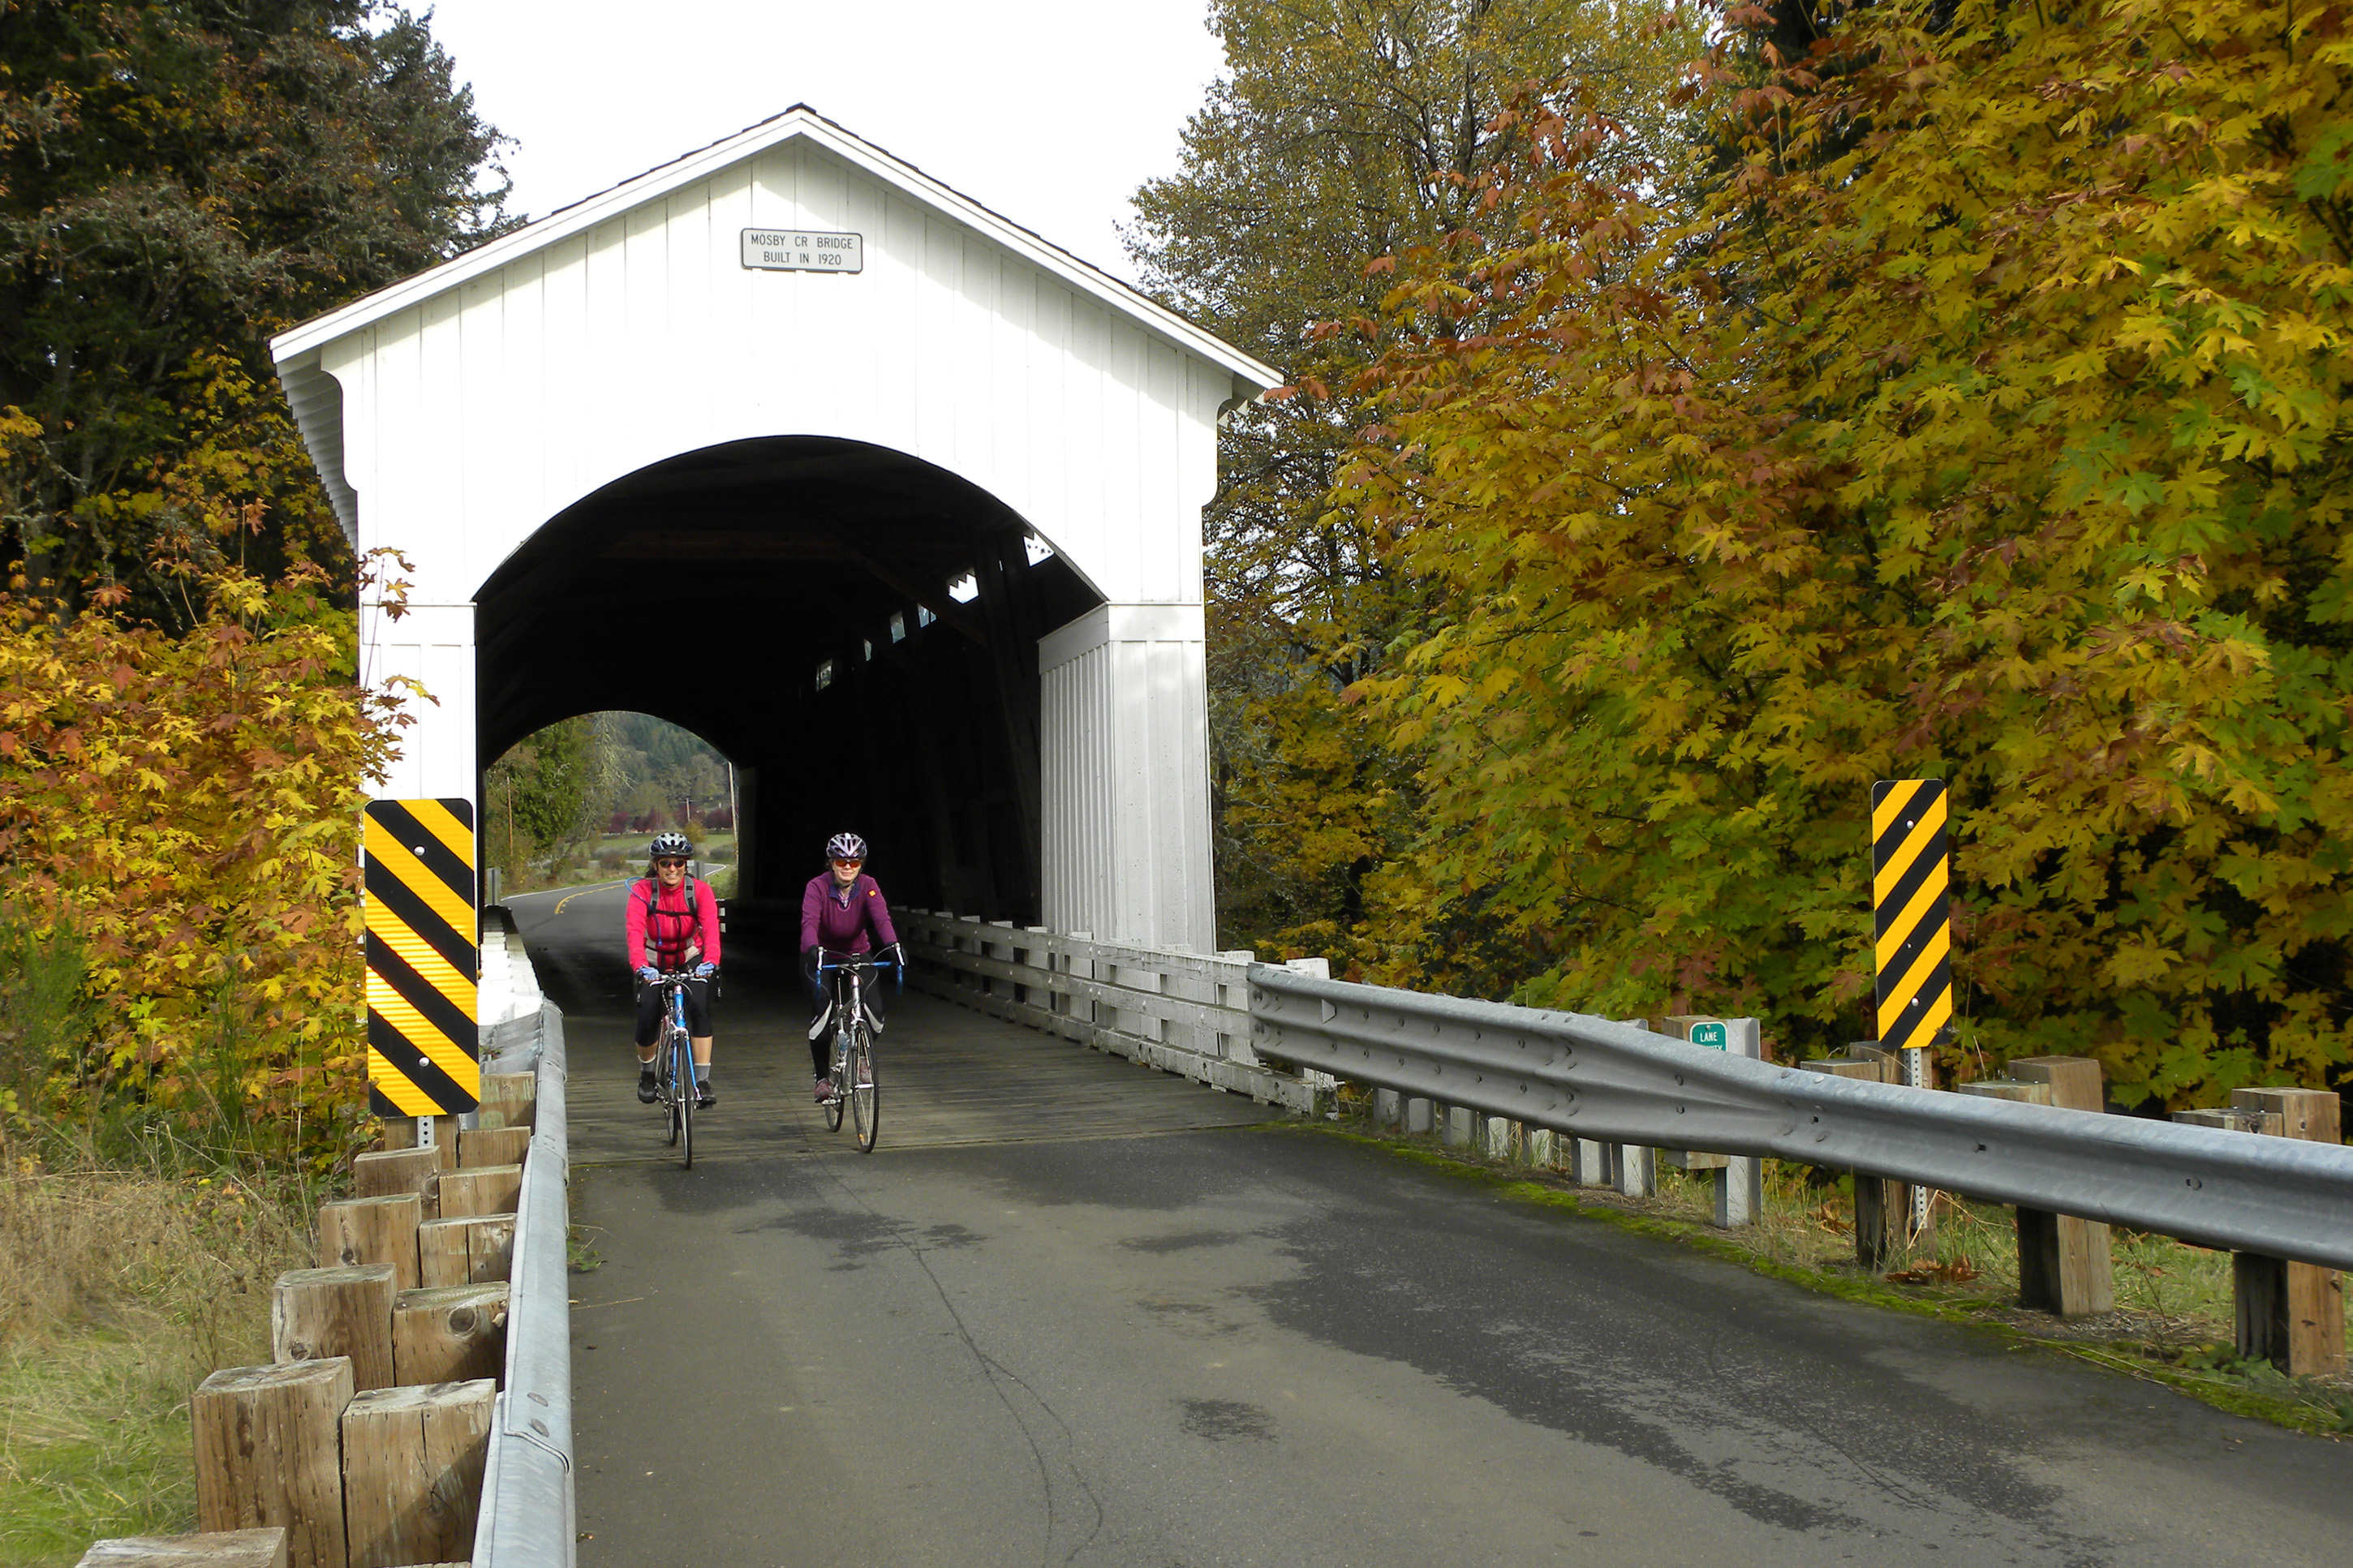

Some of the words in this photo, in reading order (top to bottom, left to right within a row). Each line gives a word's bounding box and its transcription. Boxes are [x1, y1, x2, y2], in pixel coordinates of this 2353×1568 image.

[751, 234, 786, 246] MOSBY
[794, 236, 808, 247] CR
[816, 237, 854, 250] BRIDGE
[764, 251, 791, 264] BUILT
[799, 252, 810, 264] IN
[818, 253, 842, 265] 1920
[1700, 1032, 1718, 1042] LANE
